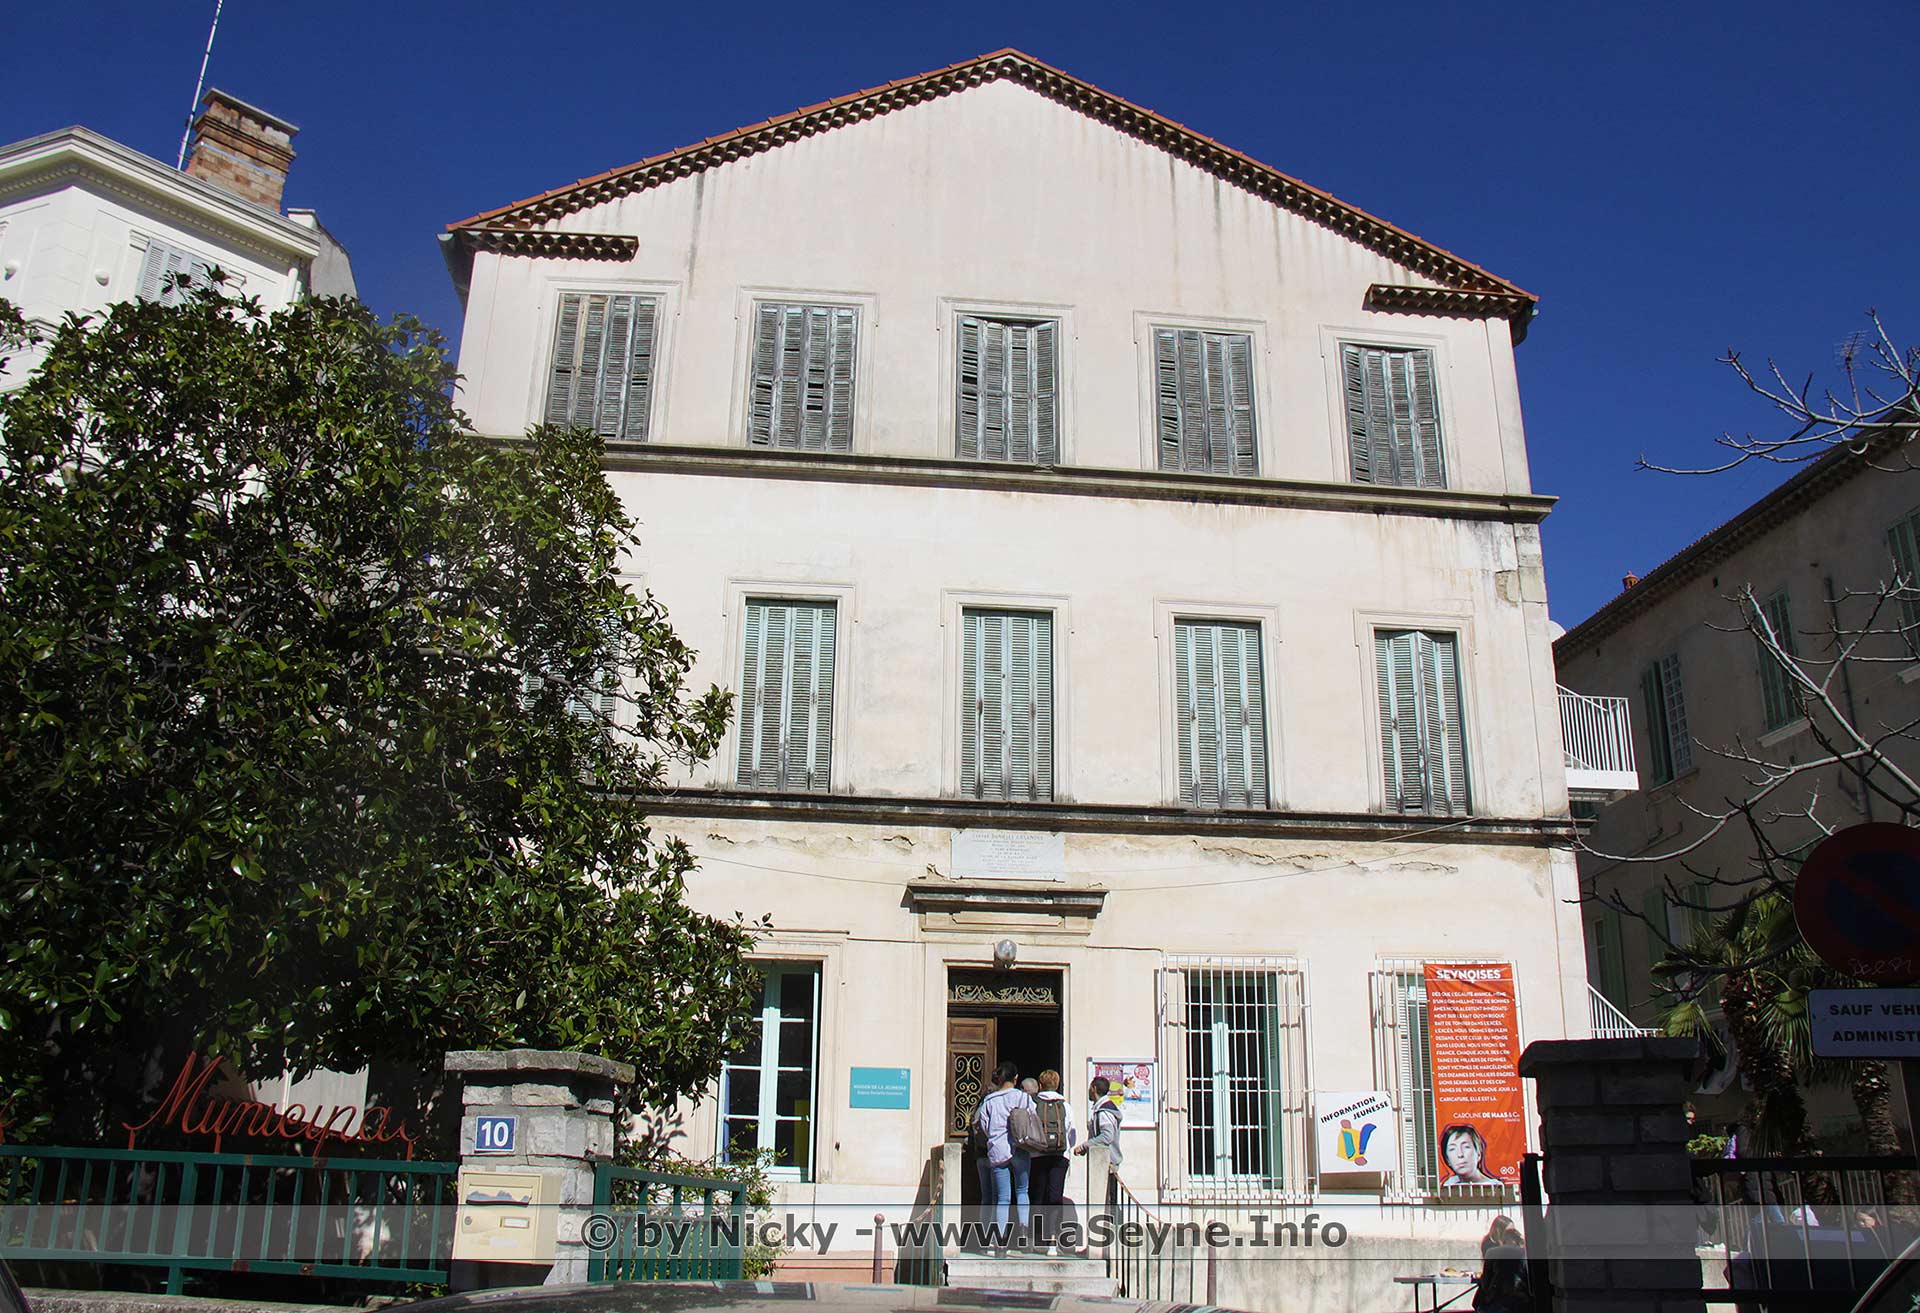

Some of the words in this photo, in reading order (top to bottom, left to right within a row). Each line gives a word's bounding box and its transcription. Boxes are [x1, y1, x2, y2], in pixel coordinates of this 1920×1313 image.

[1436, 968, 1501, 981] SEYNOISES
[1829, 1004, 1873, 1016] SAUF
[1832, 1031, 1920, 1042] ADMINIST
[1320, 1096, 1376, 1123] INFORMATION
[1353, 1101, 1389, 1120] JEUNESSE
[481, 1120, 509, 1147] 10
